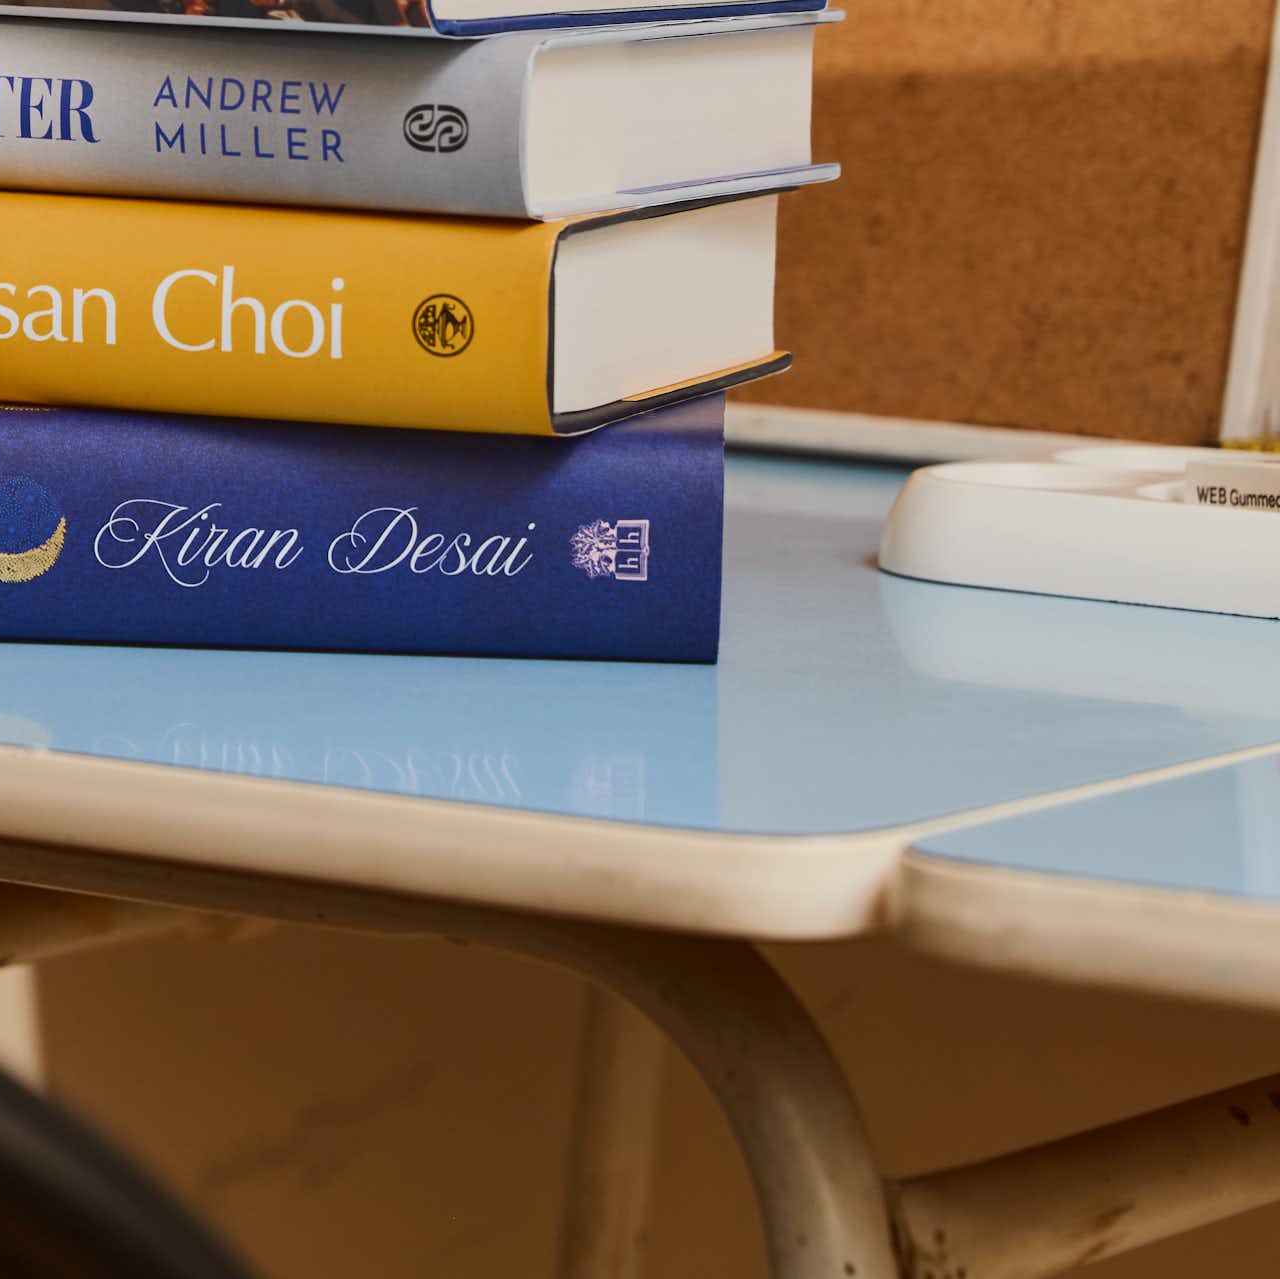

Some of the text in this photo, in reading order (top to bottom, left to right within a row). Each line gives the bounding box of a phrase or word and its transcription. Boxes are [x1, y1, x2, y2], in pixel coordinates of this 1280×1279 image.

[153, 75, 346, 116] ANDREW
[154, 121, 345, 162] MILLER
[151, 265, 345, 359] Choi
[1196, 485, 1227, 504] WEB
[94, 499, 537, 588] Kiran Desai
